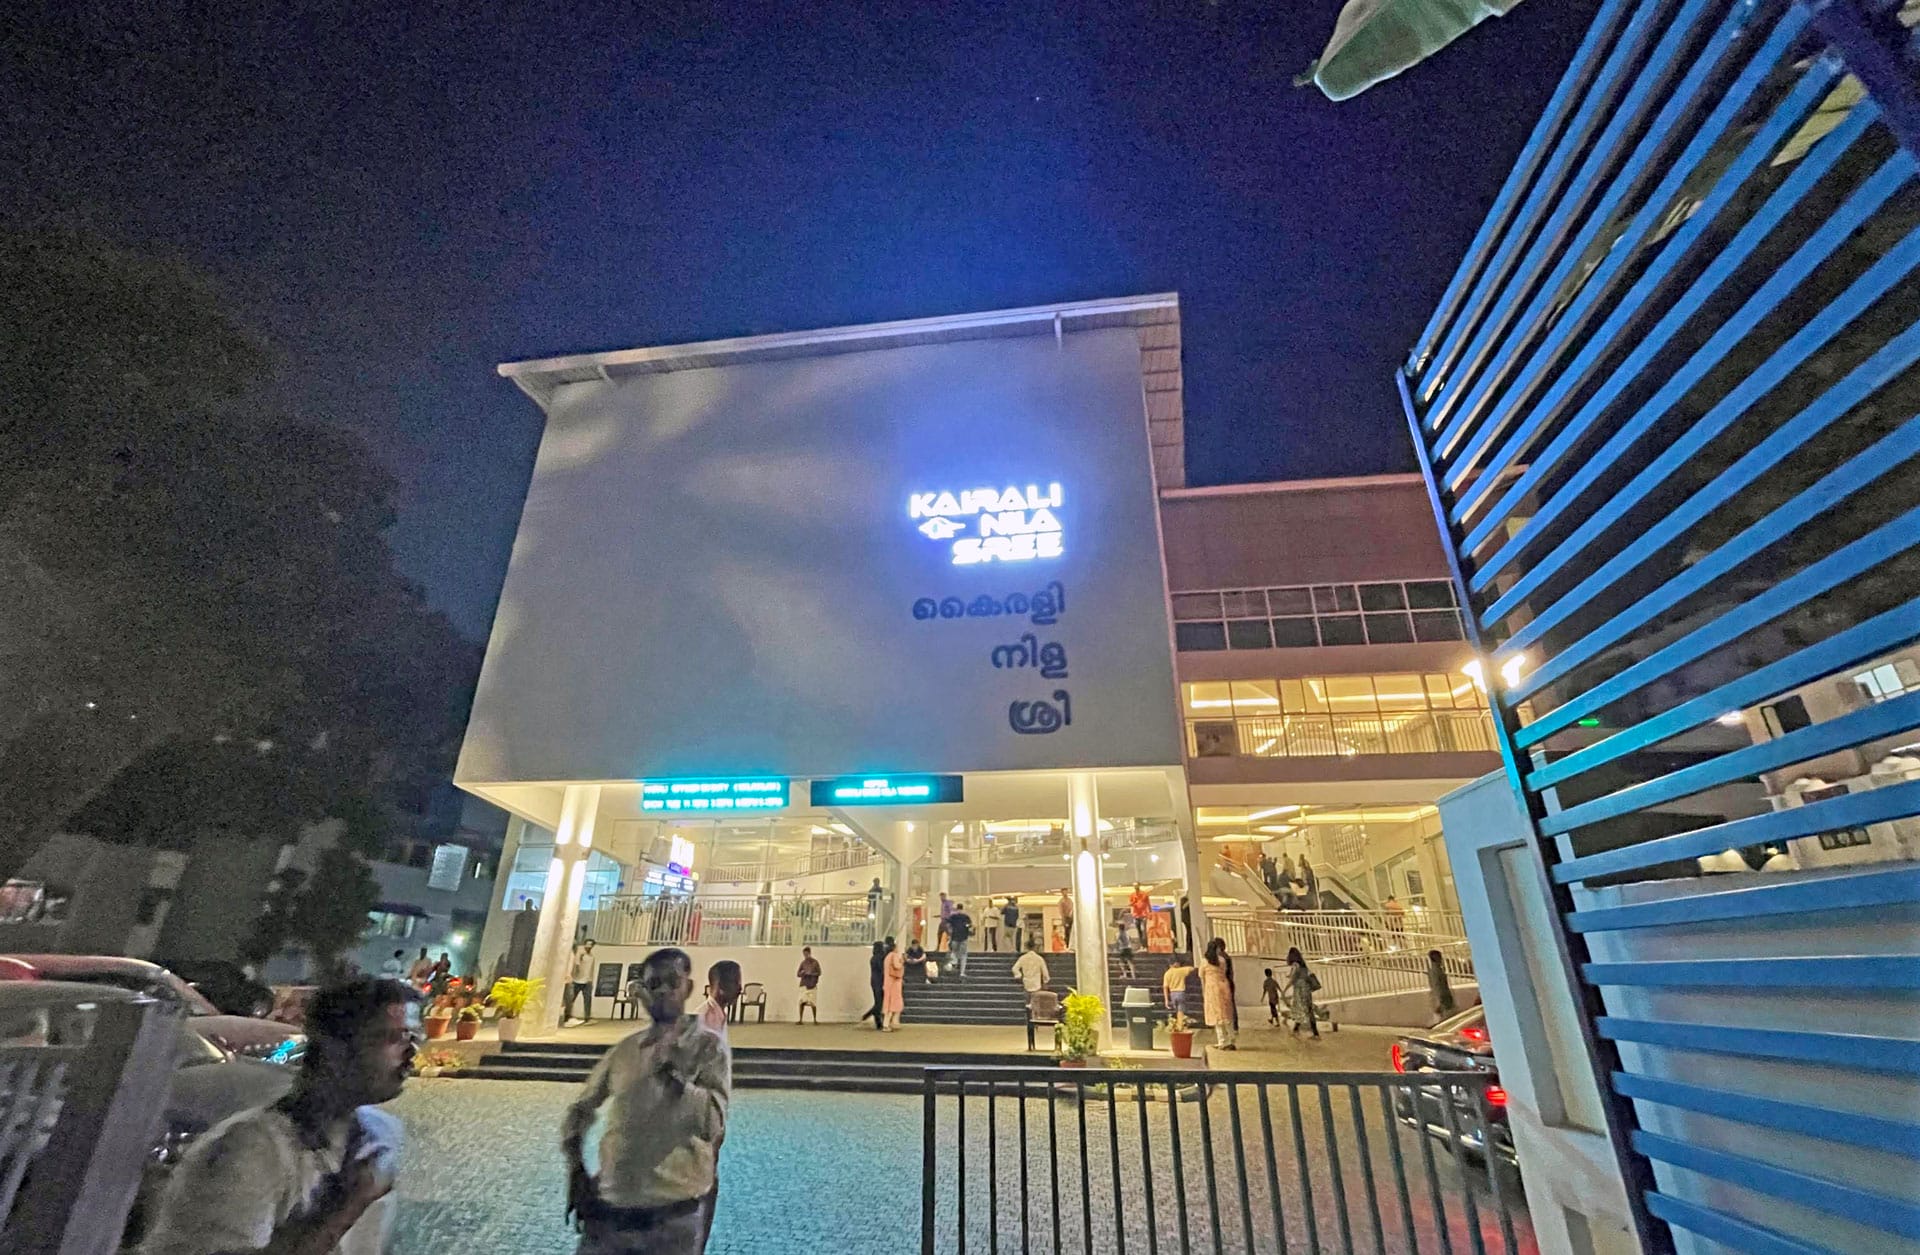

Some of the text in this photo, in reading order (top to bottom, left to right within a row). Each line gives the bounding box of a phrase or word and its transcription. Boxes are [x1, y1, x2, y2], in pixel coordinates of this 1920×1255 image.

[910, 483, 1061, 517] KAIRALI
[980, 508, 1062, 536] NILA
[952, 532, 1063, 564] SREE
[991, 633, 1068, 679] നിള
